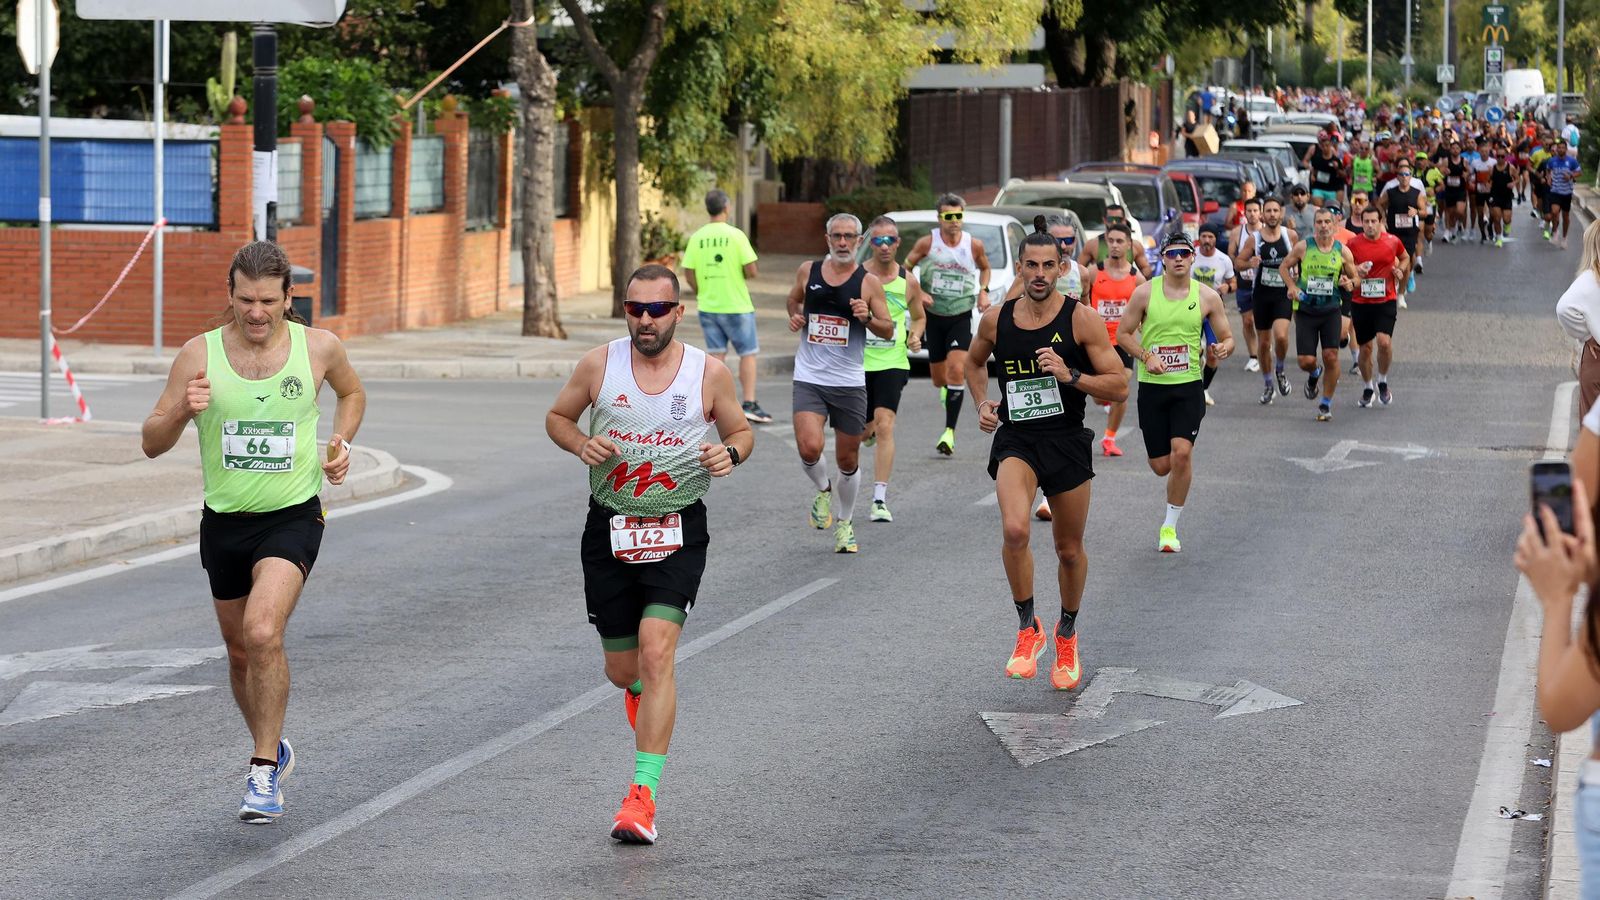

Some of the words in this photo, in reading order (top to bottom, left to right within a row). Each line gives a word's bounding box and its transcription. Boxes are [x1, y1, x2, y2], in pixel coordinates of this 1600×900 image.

[1104, 307, 1120, 315] 483
[818, 325, 839, 336] 250
[1160, 355, 1180, 364] 204
[1005, 359, 1035, 375] ELI
[1024, 392, 1042, 406] 38
[608, 428, 685, 447] maratón
[247, 437, 270, 455] 66
[625, 448, 662, 457] JEREZ
[629, 529, 665, 547] 142
